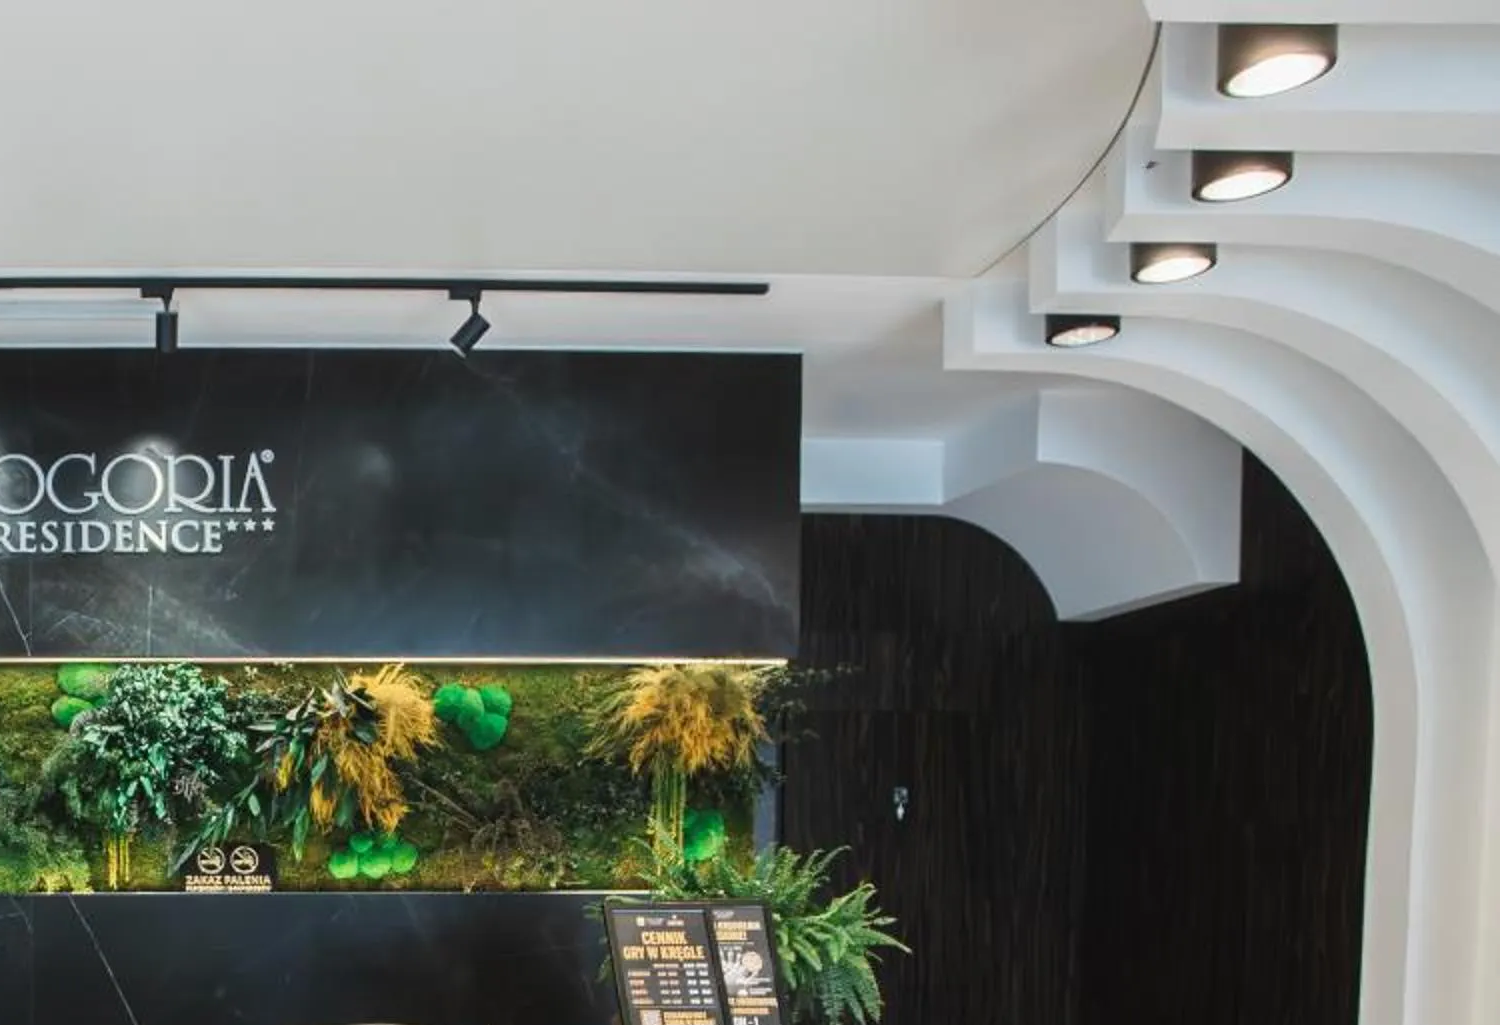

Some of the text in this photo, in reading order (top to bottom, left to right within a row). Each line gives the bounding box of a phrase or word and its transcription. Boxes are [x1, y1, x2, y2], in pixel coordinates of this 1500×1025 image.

[185, 875, 272, 885] ZAKAZ PALENIA
[641, 931, 687, 945] CENNIK
[623, 945, 645, 960] GRY
[646, 945, 658, 959] W
